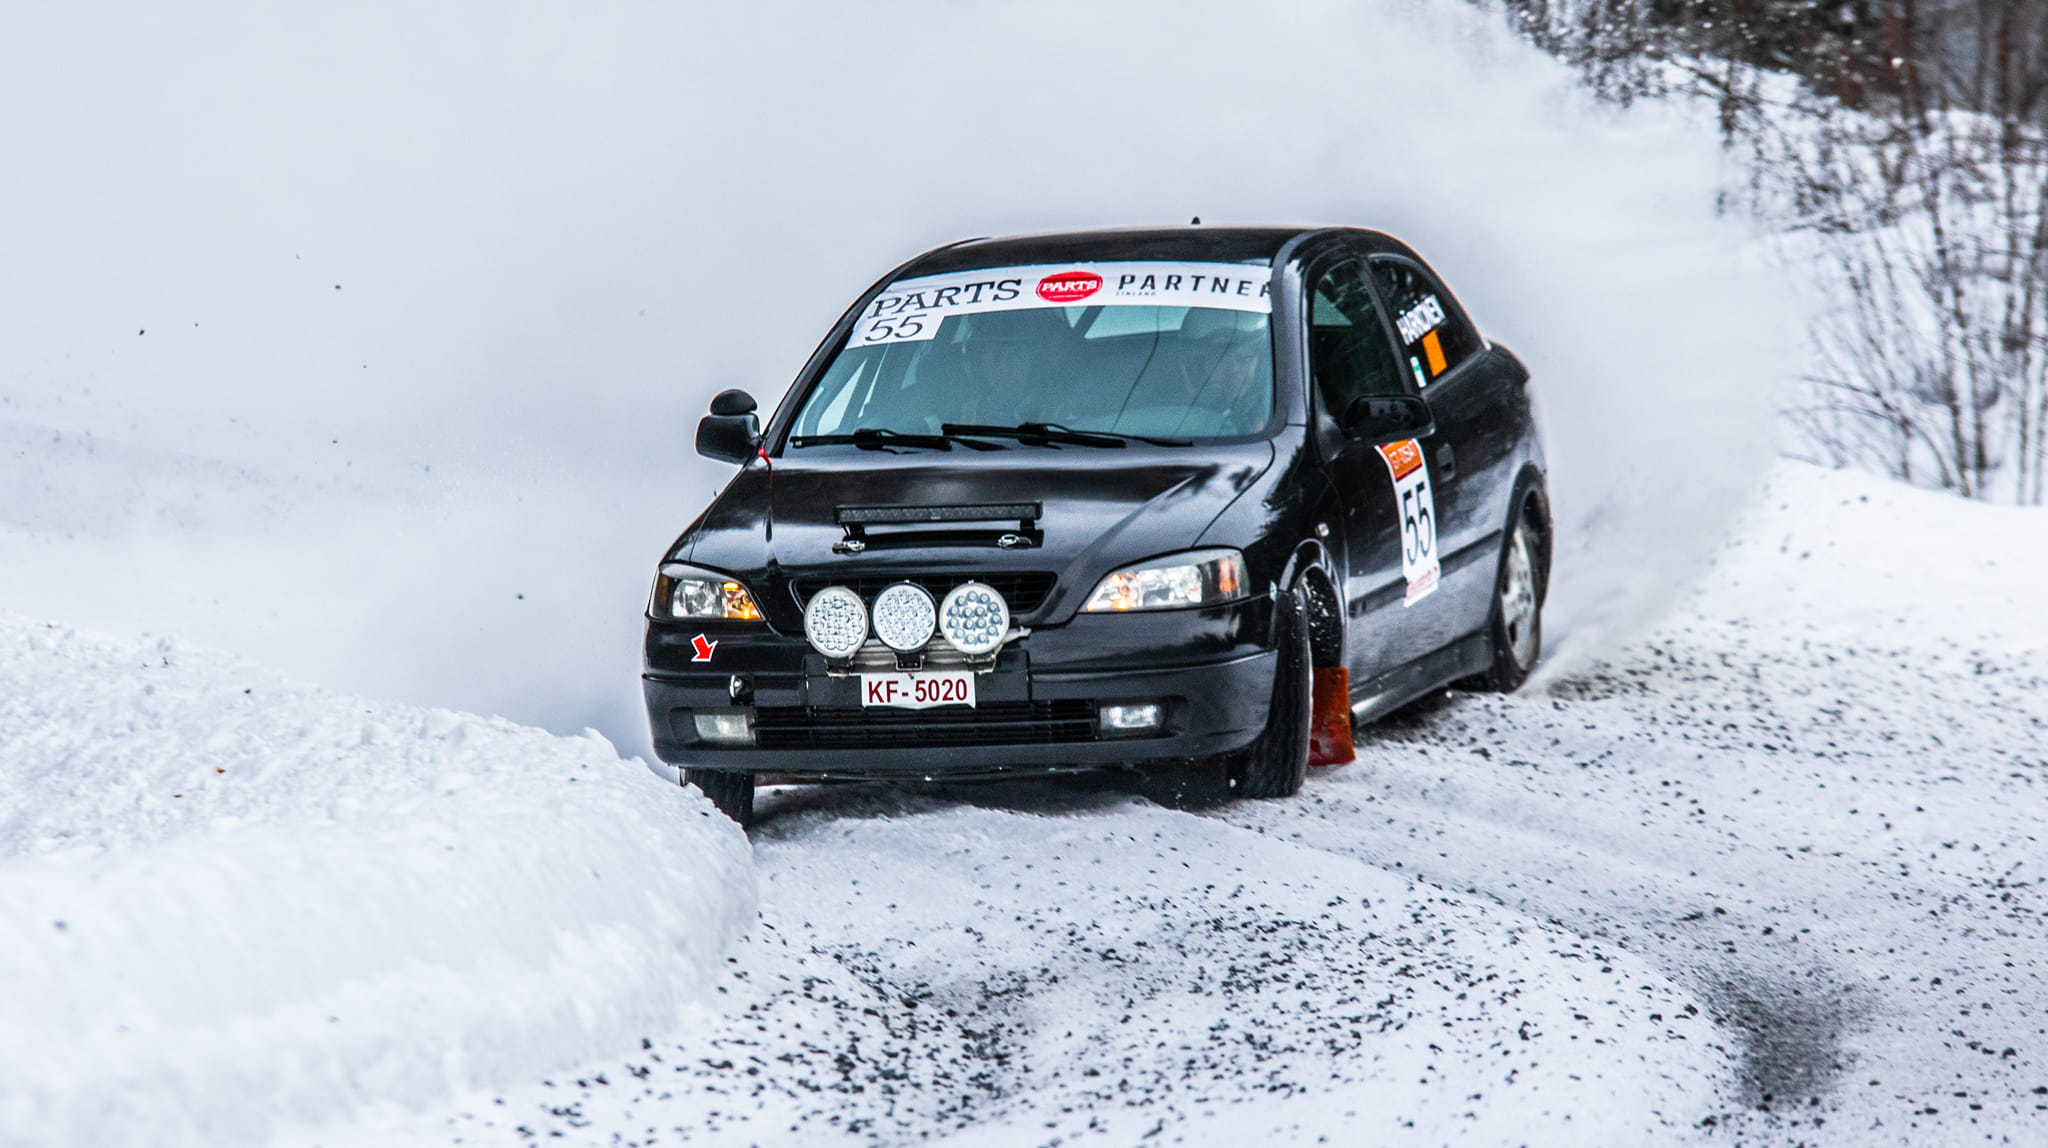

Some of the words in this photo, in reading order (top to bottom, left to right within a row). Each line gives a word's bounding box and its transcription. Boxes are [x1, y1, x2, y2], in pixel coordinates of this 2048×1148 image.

[868, 278, 1022, 319] PARTS
[1041, 279, 1098, 292] PARTS
[865, 314, 928, 342] 55
[1402, 481, 1432, 566] 55
